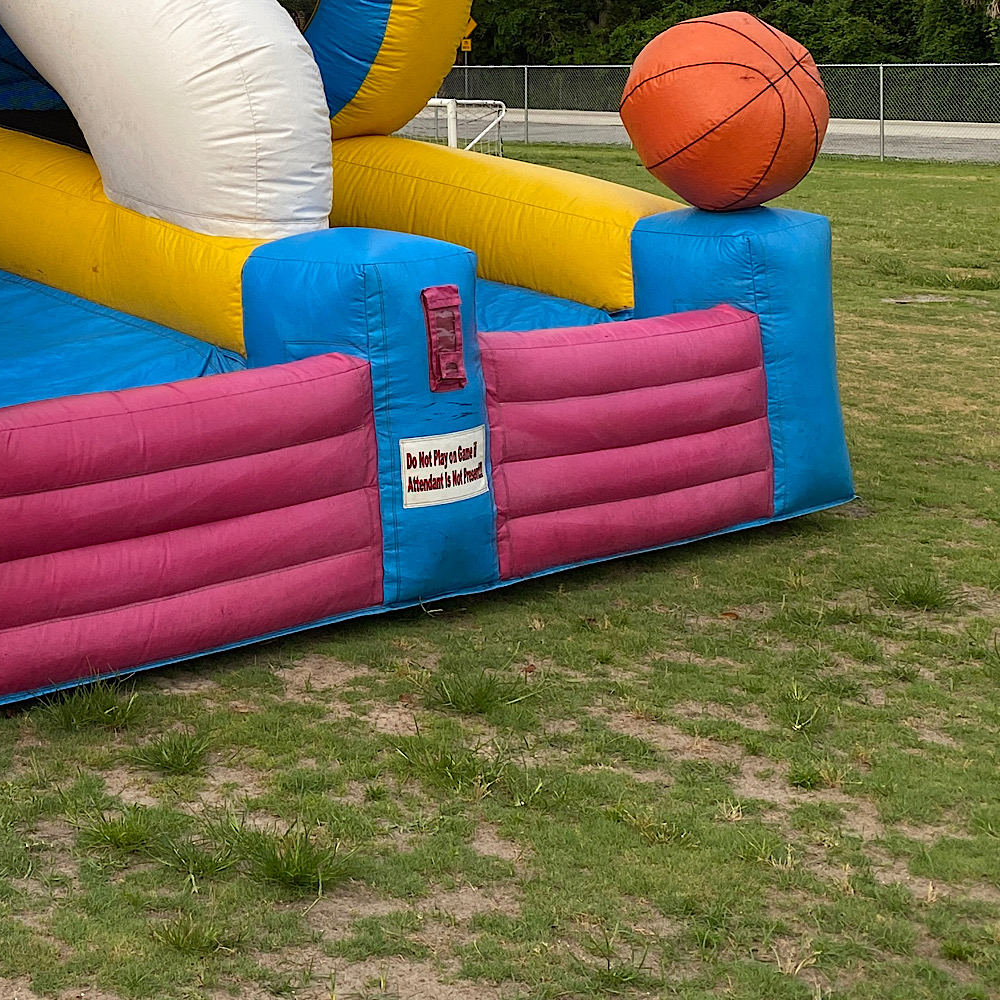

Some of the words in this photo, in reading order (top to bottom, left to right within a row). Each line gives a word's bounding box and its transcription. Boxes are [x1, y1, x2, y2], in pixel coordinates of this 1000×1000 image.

[406, 453, 417, 469] Do
[418, 451, 432, 468] Not
[433, 449, 448, 469] Play
[449, 451, 457, 464] on
[457, 445, 472, 462] Game
[407, 473, 444, 493] Attendant
[444, 472, 451, 488] Is
[452, 469, 463, 487] Not
